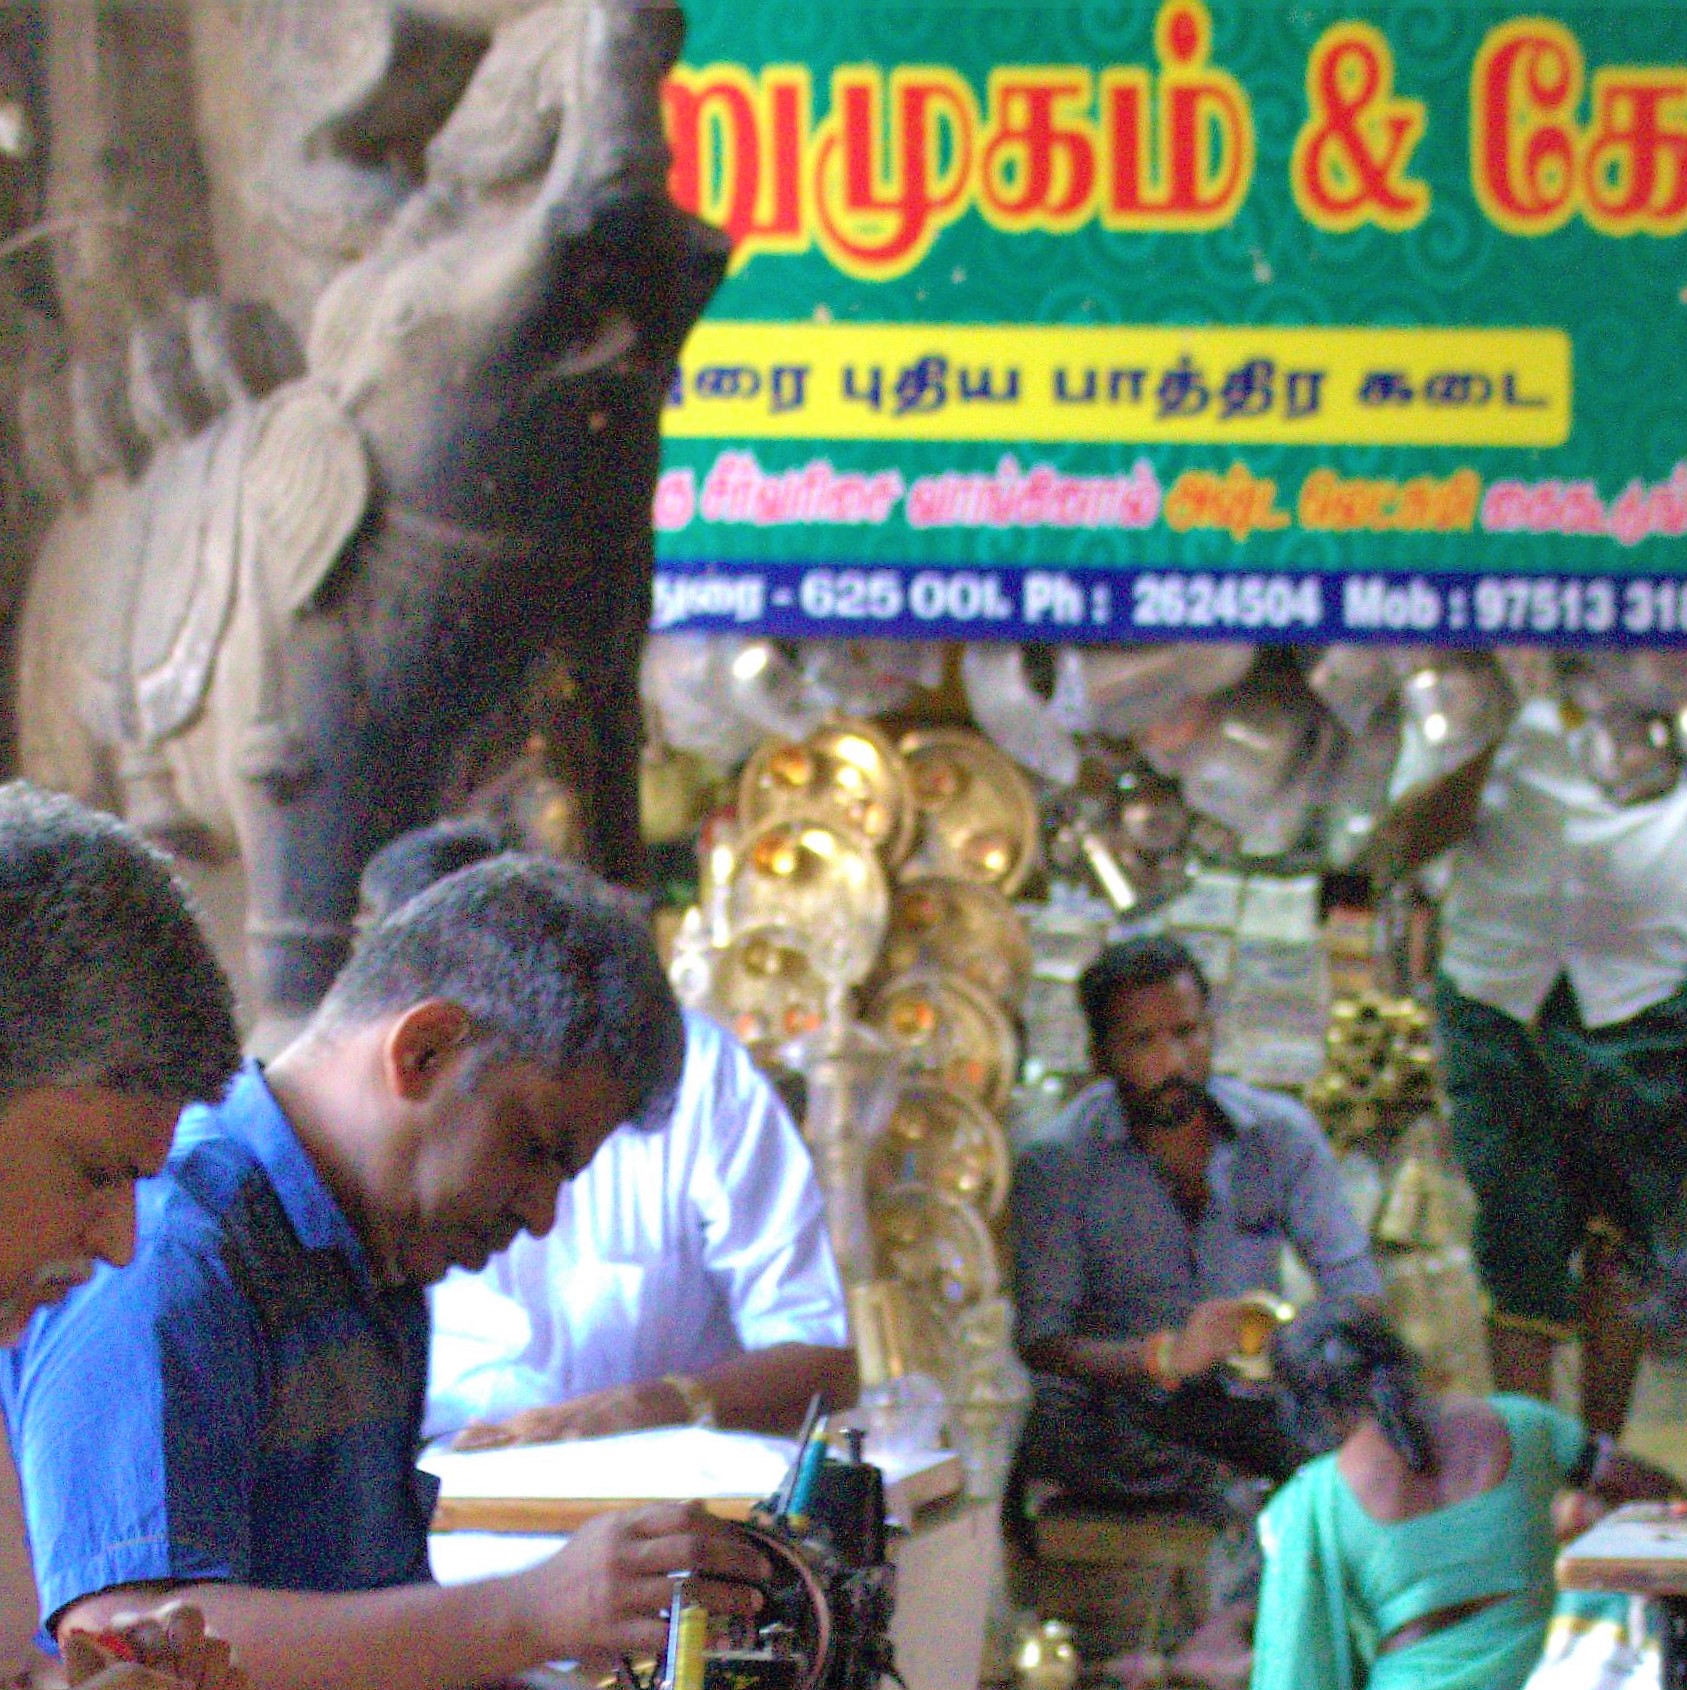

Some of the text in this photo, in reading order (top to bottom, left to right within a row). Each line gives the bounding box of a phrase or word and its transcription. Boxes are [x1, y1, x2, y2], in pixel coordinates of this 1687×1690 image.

[1290, 18, 1430, 233] &
[842, 350, 1020, 416] புதிய
[1054, 354, 1325, 421] பாத்திர
[1358, 367, 1550, 409] கடை
[802, 567, 903, 620] 625
[1133, 573, 1322, 627] 2624504
[1475, 576, 1615, 633] 97513
